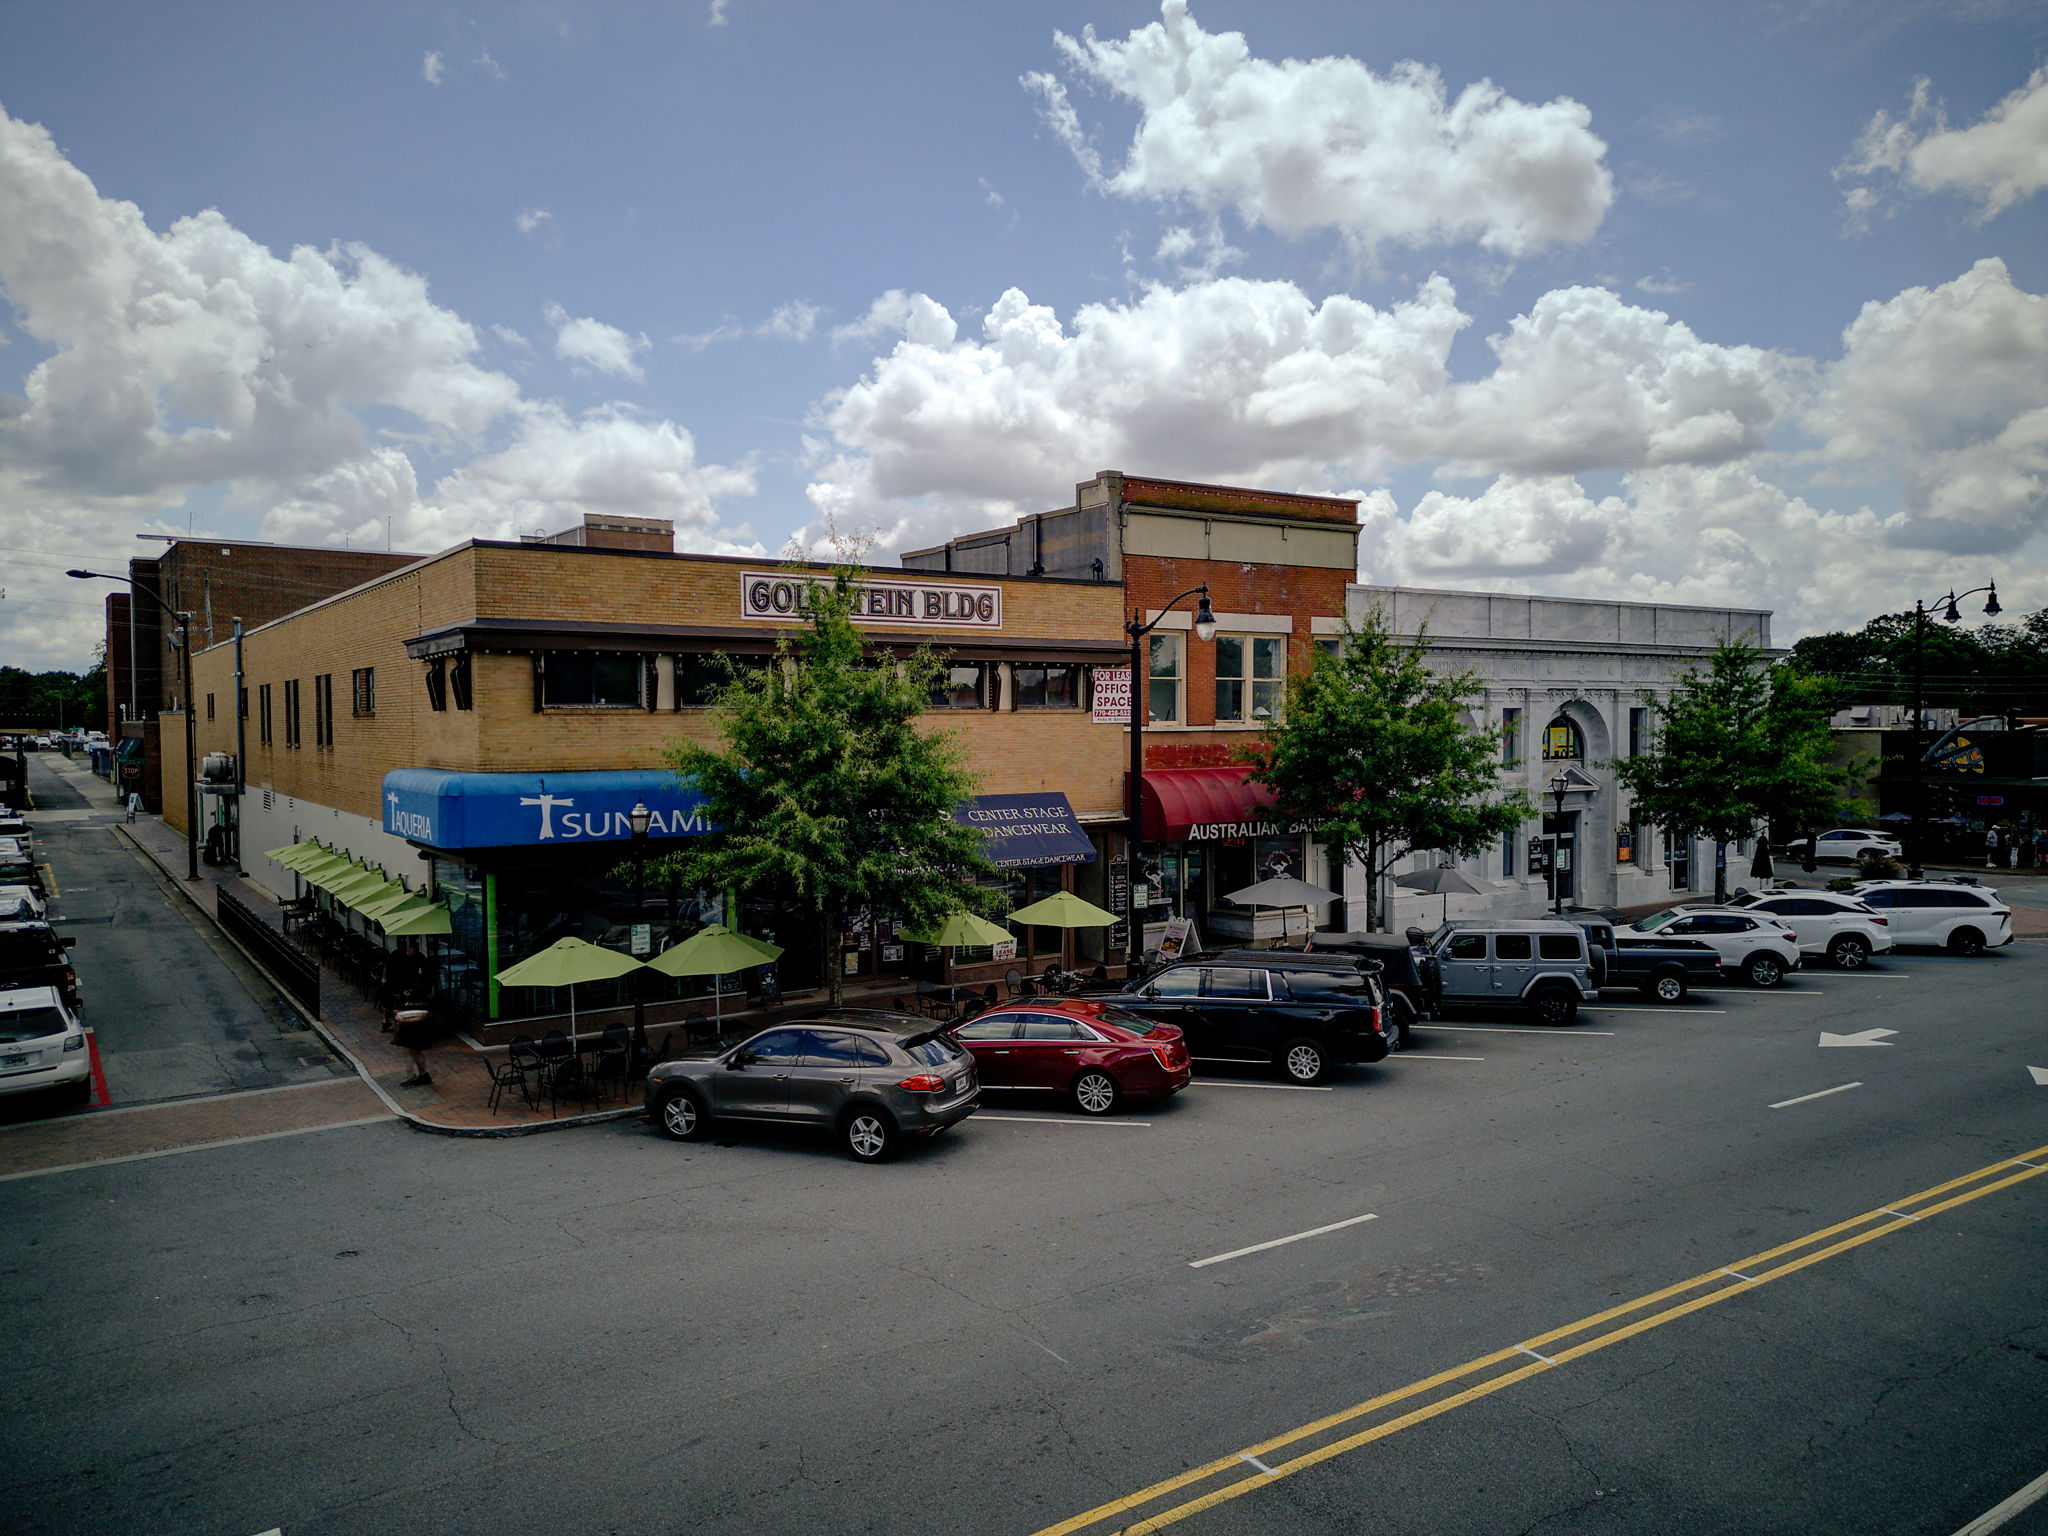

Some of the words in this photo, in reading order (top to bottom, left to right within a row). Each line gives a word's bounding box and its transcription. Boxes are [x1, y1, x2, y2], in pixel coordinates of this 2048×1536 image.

[749, 580, 916, 617] GOLTEIN
[922, 589, 994, 622] BLDG
[1095, 671, 1110, 681] FOR
[1112, 671, 1132, 681] LEAS
[387, 791, 432, 840] TAQUERIA
[520, 794, 712, 840] TSUNAMI
[968, 808, 1024, 821] CENTER
[1024, 806, 1068, 819] STAGE
[981, 823, 1072, 838] DANCEWEAR
[1188, 821, 1280, 841] AUSTRALIAN
[995, 858, 1022, 868] CENTER
[1022, 856, 1044, 866] STAGE
[1044, 853, 1086, 863] DANCEWEAR
